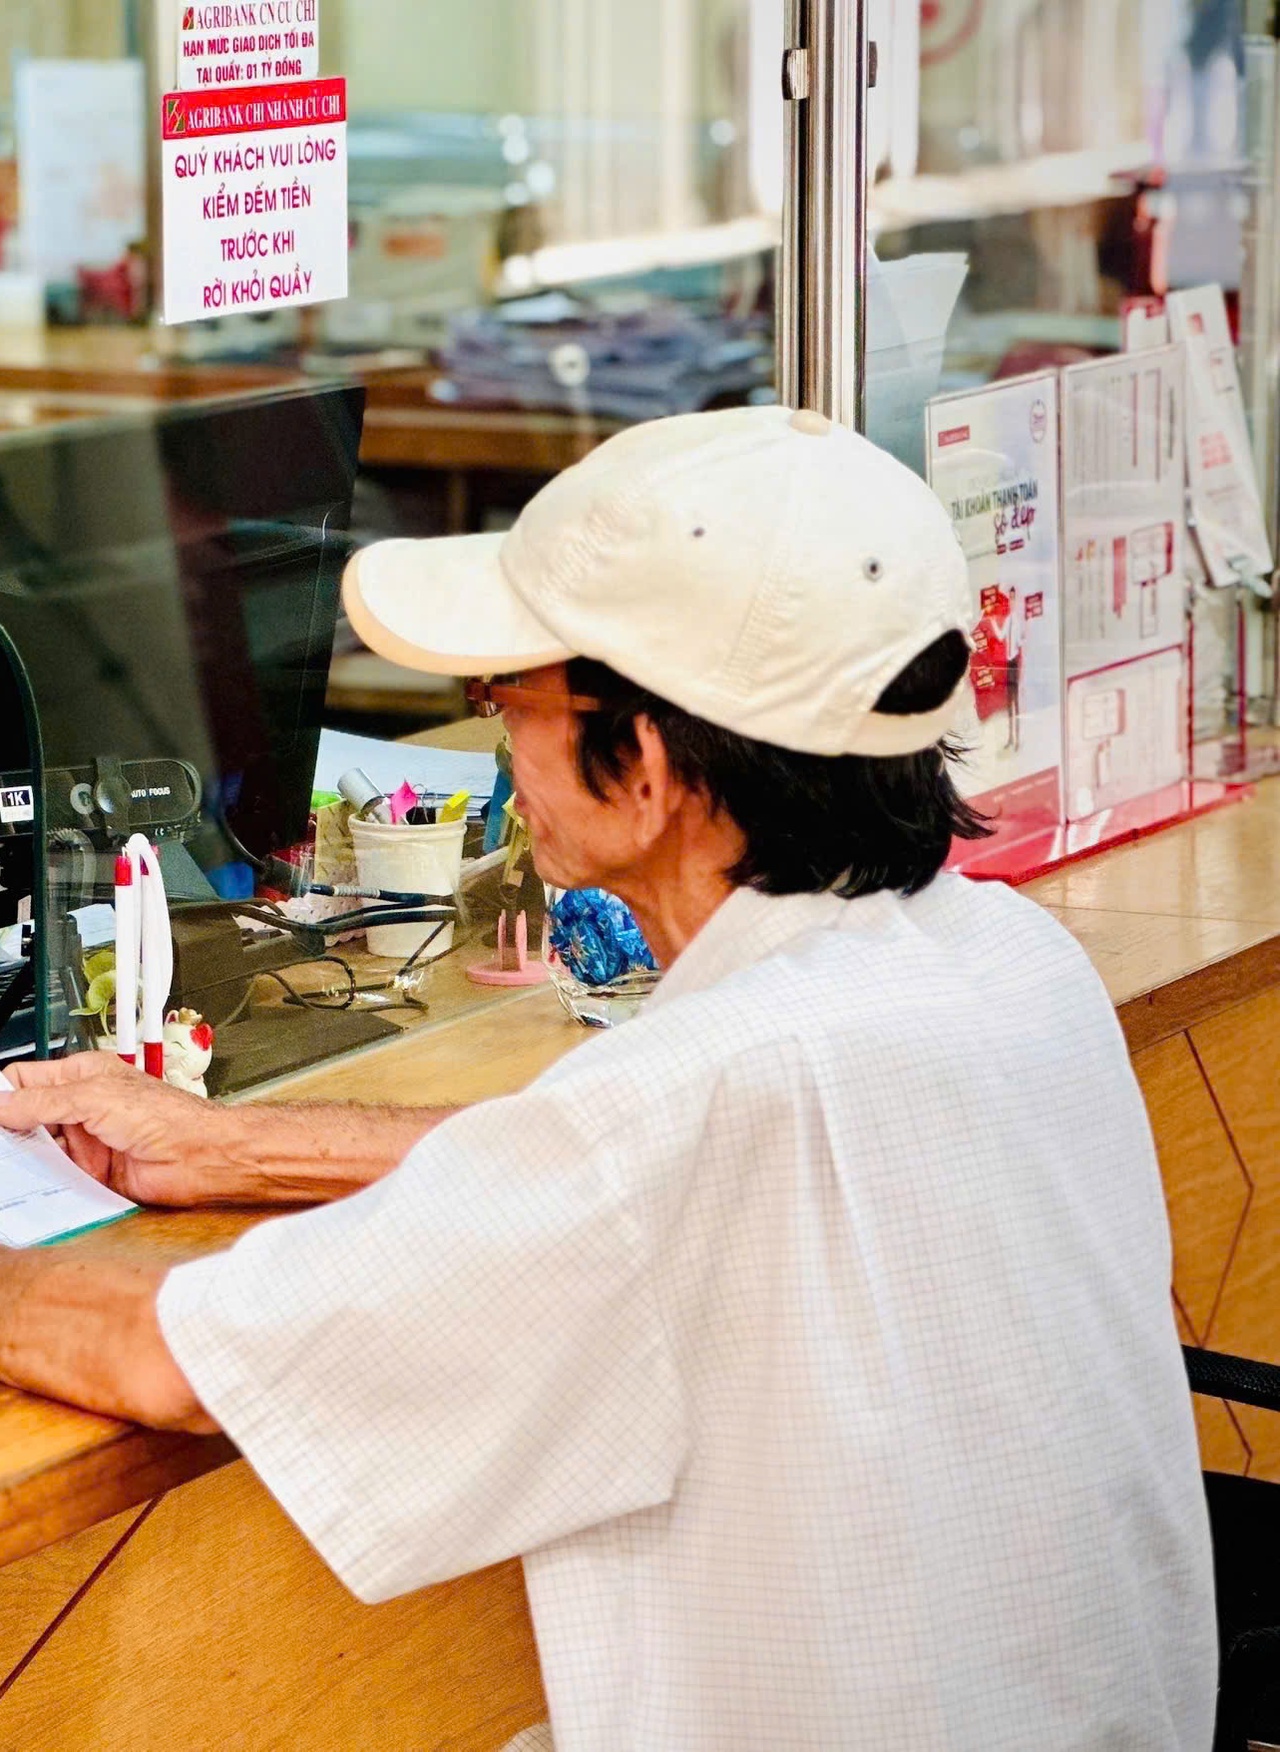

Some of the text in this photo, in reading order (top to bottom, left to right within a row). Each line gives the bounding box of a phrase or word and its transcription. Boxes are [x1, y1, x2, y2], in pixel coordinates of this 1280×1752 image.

[197, 3, 256, 30] AGRIBANK
[259, 2, 275, 25] CN
[296, 0, 316, 23] CHI
[183, 40, 204, 60] HẠN
[232, 35, 256, 54] GIAO
[258, 33, 281, 55] DỊCH
[301, 31, 315, 48] ĐA
[196, 67, 212, 87] TẠI
[246, 63, 258, 80] 01
[187, 104, 244, 129] AGRIBANK
[245, 102, 265, 125] CHI
[266, 92, 303, 122] NHÁNH
[321, 94, 340, 117] CHI
[174, 134, 336, 178] QUÝ KHÁCH VUI LÒNG
[203, 176, 311, 220] KIỂM ĐẾM TIỀN
[220, 228, 295, 262] TRƯỚC KHI
[203, 277, 227, 309] RỜI
[231, 269, 265, 305] KHỎI
[149, 786, 171, 797] FOCUS
